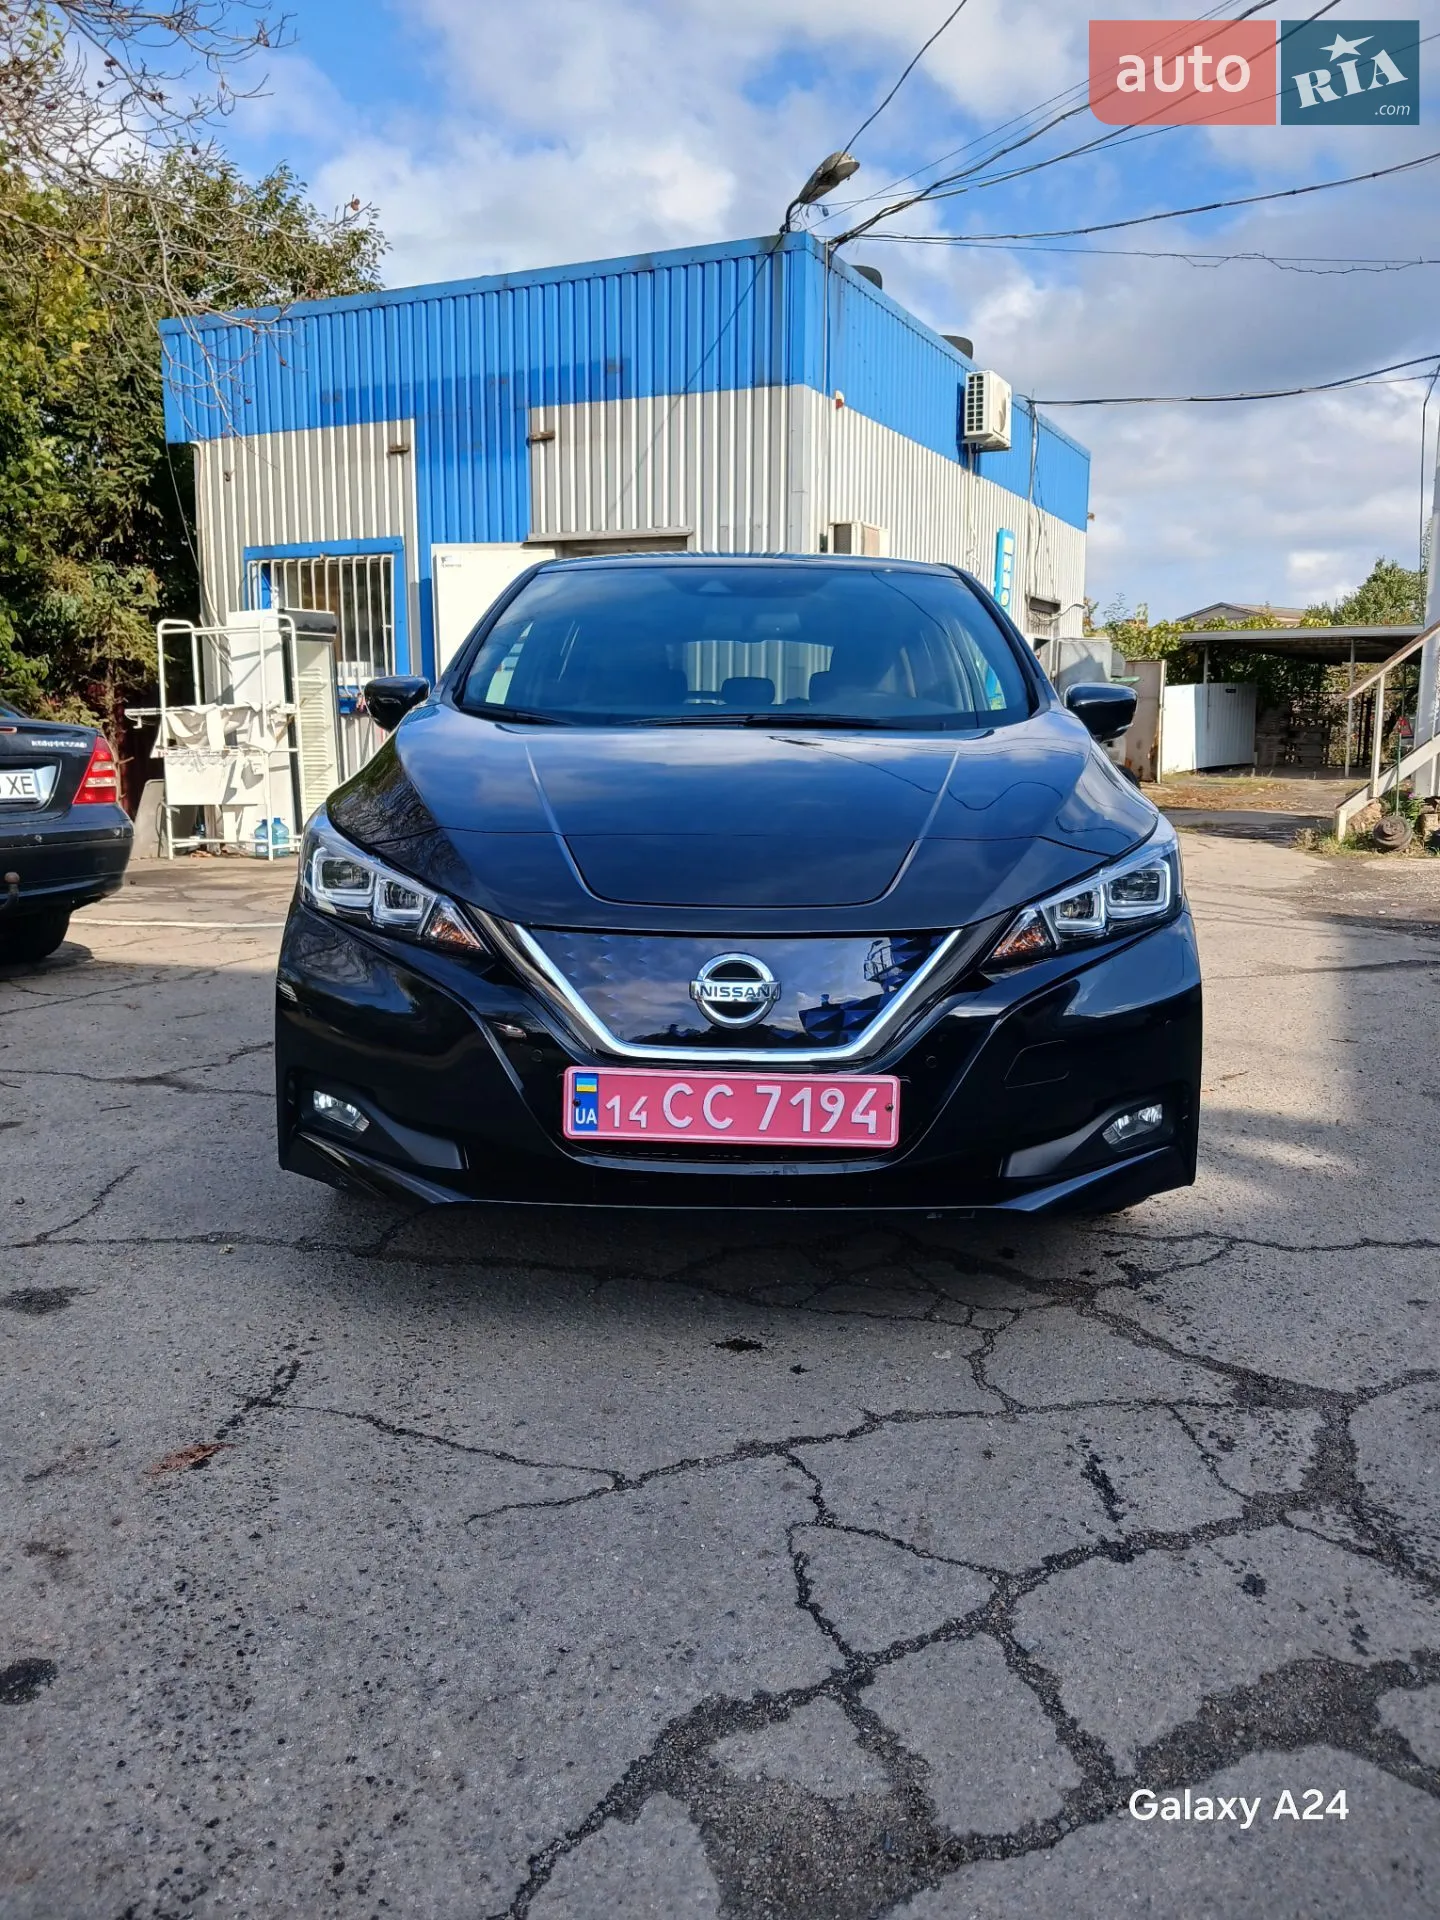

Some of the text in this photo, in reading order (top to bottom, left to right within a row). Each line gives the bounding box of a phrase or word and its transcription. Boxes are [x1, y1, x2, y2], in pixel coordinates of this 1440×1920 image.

[6, 775, 35, 795] XE
[699, 985, 770, 998] NISSAN
[575, 1107, 598, 1125] UA
[605, 1082, 878, 1135] 14 CC 7194
